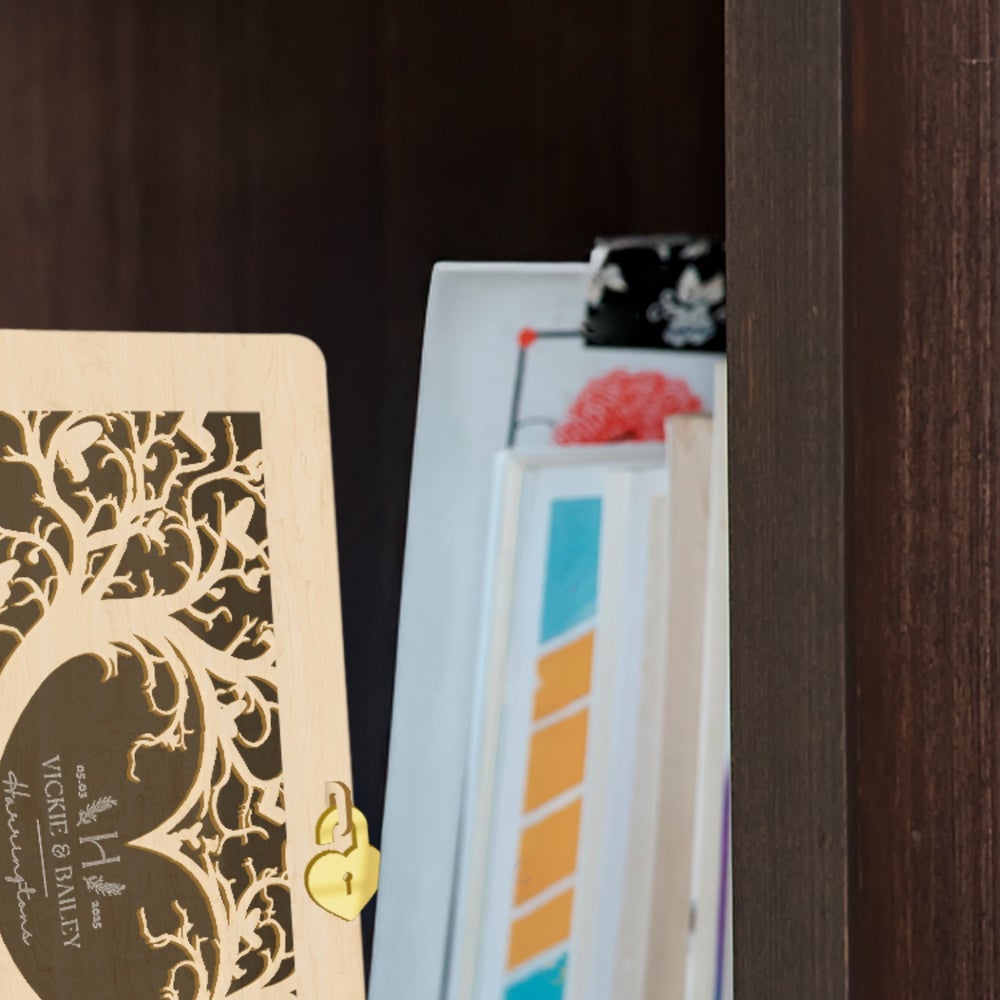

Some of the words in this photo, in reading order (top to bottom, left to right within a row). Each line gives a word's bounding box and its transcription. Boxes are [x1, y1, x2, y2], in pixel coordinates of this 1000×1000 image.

[42, 754, 69, 837] VICKIE
[2, 770, 37, 947] Harringtons
[51, 843, 71, 859] &
[79, 831, 121, 869] H
[55, 865, 81, 949] BAILEY
[91, 901, 103, 930] 2025
